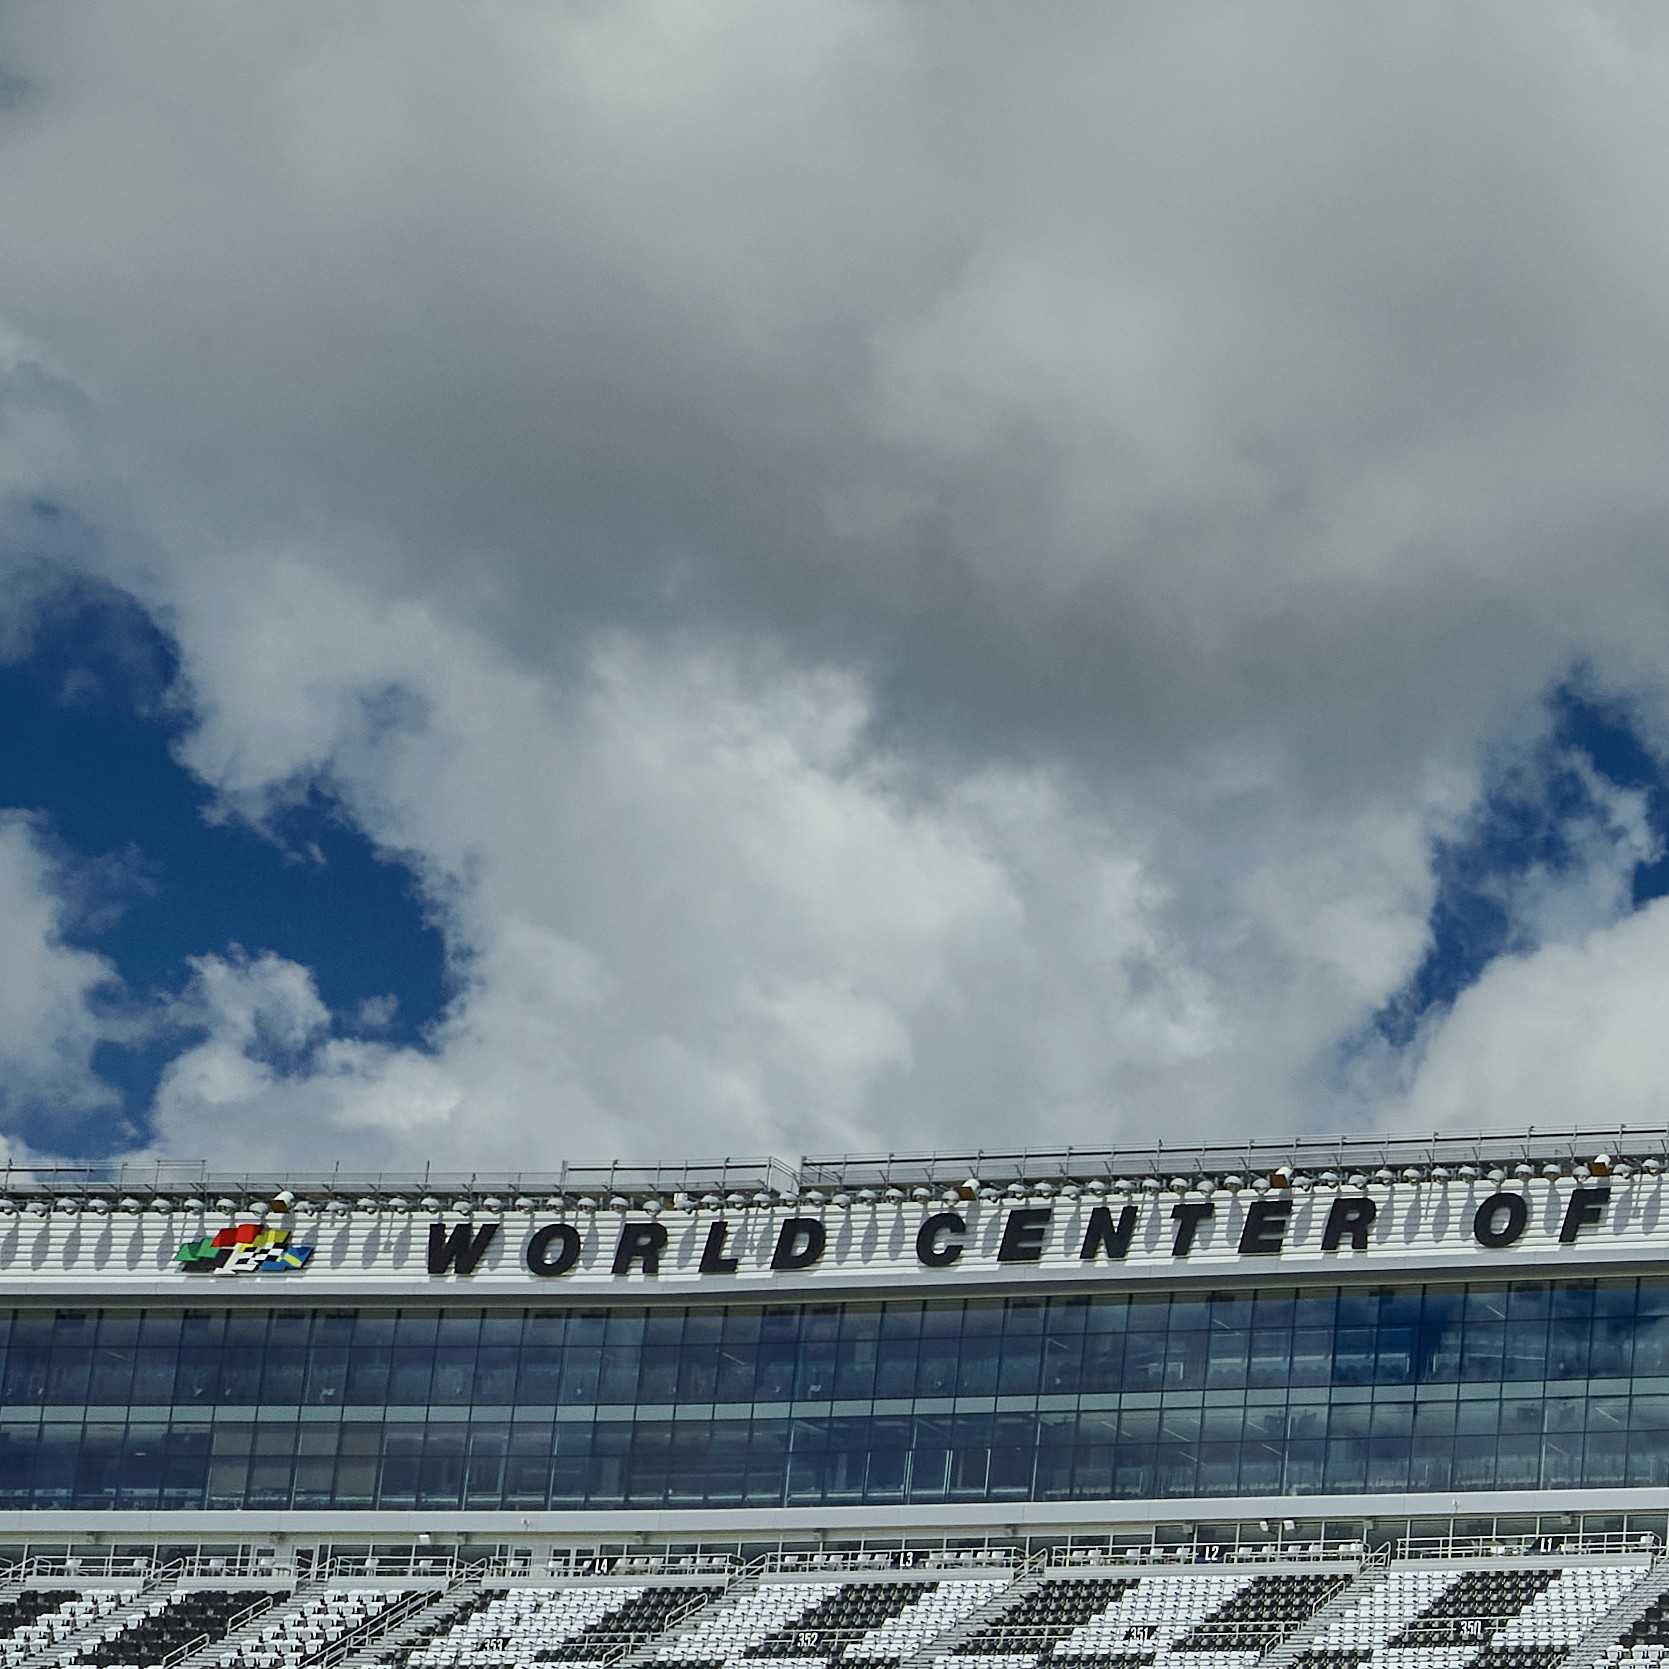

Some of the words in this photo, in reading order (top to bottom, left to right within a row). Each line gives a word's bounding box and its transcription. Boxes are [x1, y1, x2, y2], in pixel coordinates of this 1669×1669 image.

[427, 1217, 826, 1276] WORLD
[916, 1197, 1377, 1267] CENTER
[1474, 1187, 1611, 1249] OF
[1540, 1538, 1552, 1552] L1
[899, 1552, 913, 1567] L3
[1204, 1546, 1219, 1560] L2
[595, 1558, 608, 1573] L4
[1130, 1627, 1149, 1640] 351
[1460, 1620, 1481, 1635] 350
[484, 1638, 503, 1651] 353
[797, 1632, 818, 1647] 352
